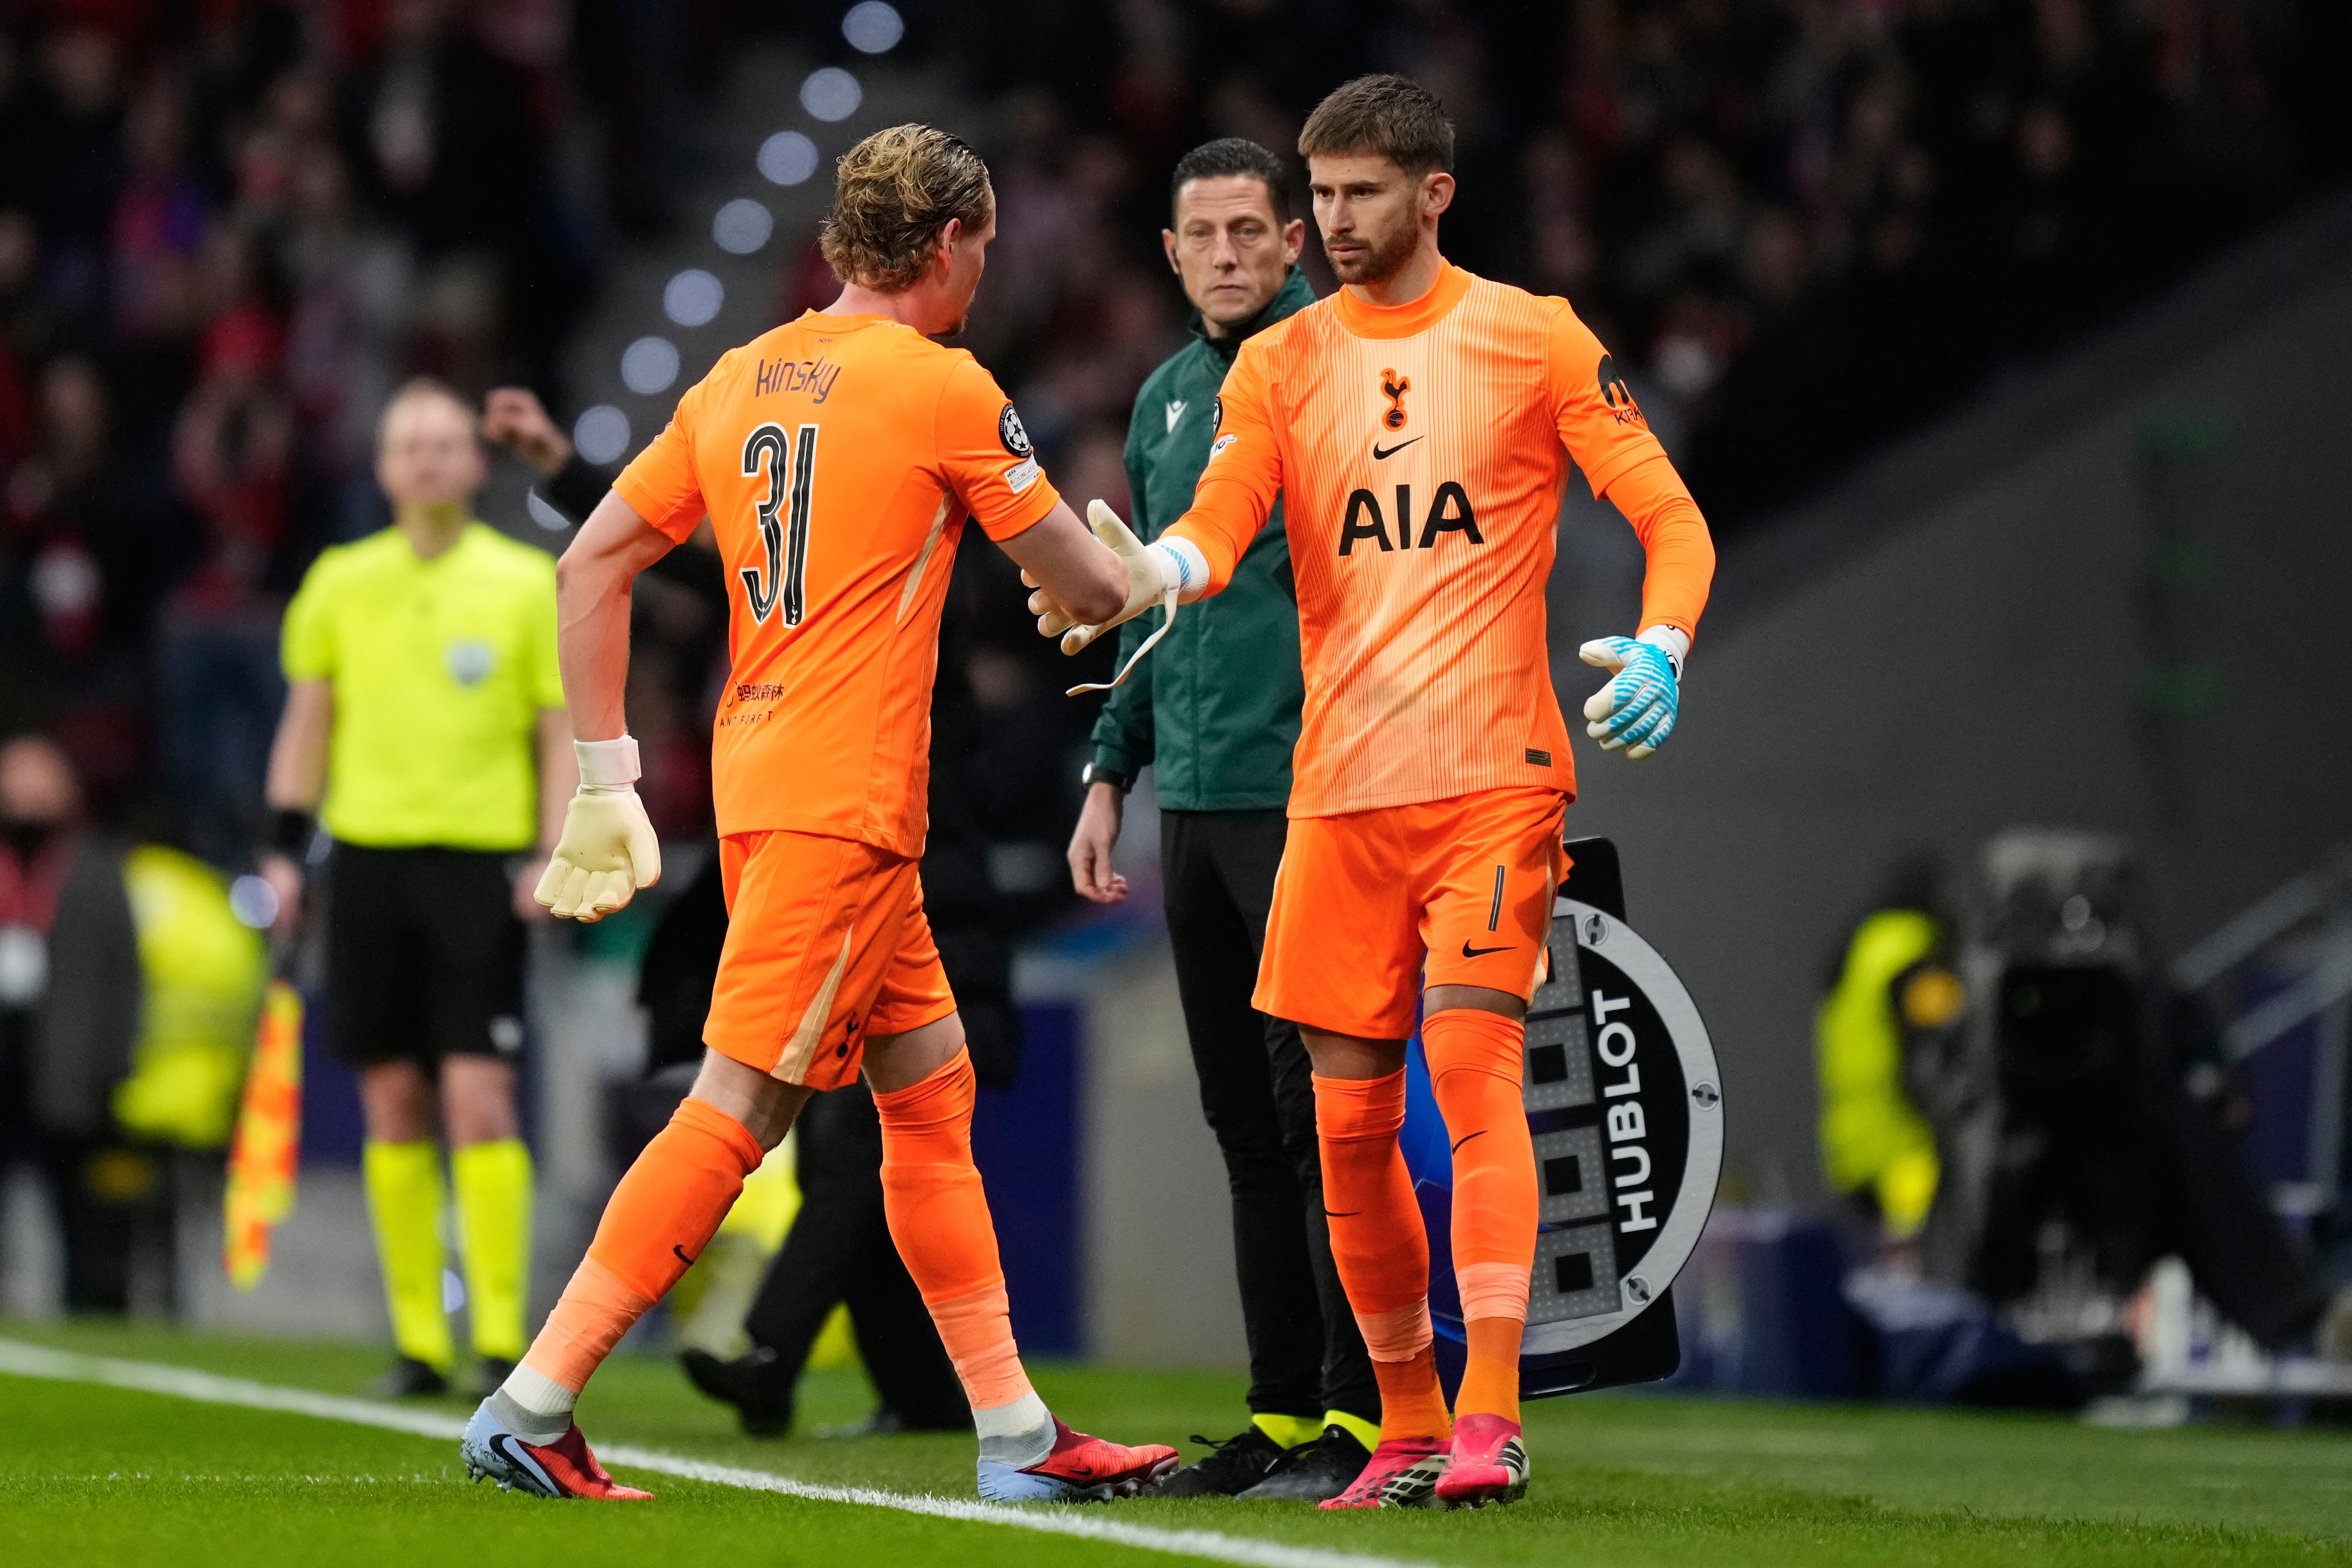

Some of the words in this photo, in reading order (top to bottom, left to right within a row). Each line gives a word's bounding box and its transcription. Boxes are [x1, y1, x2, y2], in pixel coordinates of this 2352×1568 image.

[755, 356, 841, 404] kinsky
[740, 421, 819, 629] 31
[1338, 481, 1484, 557] AIA
[740, 711, 773, 725] FORET
[1592, 989, 1657, 1233] HUBLOT
